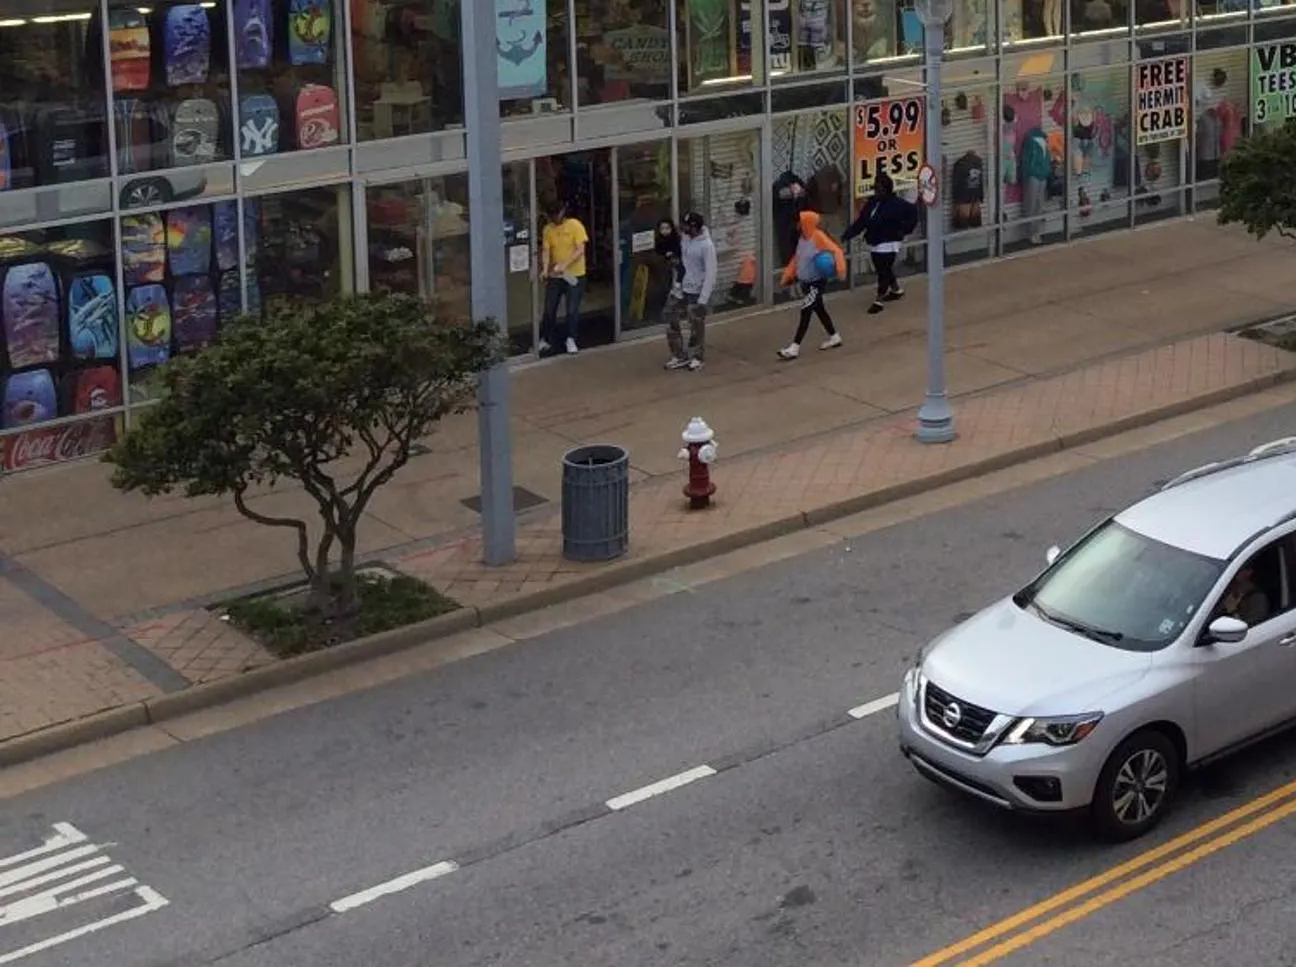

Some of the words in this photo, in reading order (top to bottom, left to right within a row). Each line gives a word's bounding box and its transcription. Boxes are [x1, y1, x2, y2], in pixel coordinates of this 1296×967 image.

[1140, 59, 1185, 89] FREE
[1258, 72, 1296, 93] TEES
[1139, 86, 1185, 110] HERMIT
[1257, 99, 1266, 121] 3
[1140, 107, 1185, 132] CRAB
[877, 138, 898, 152] OR
[861, 151, 918, 180] LESS
